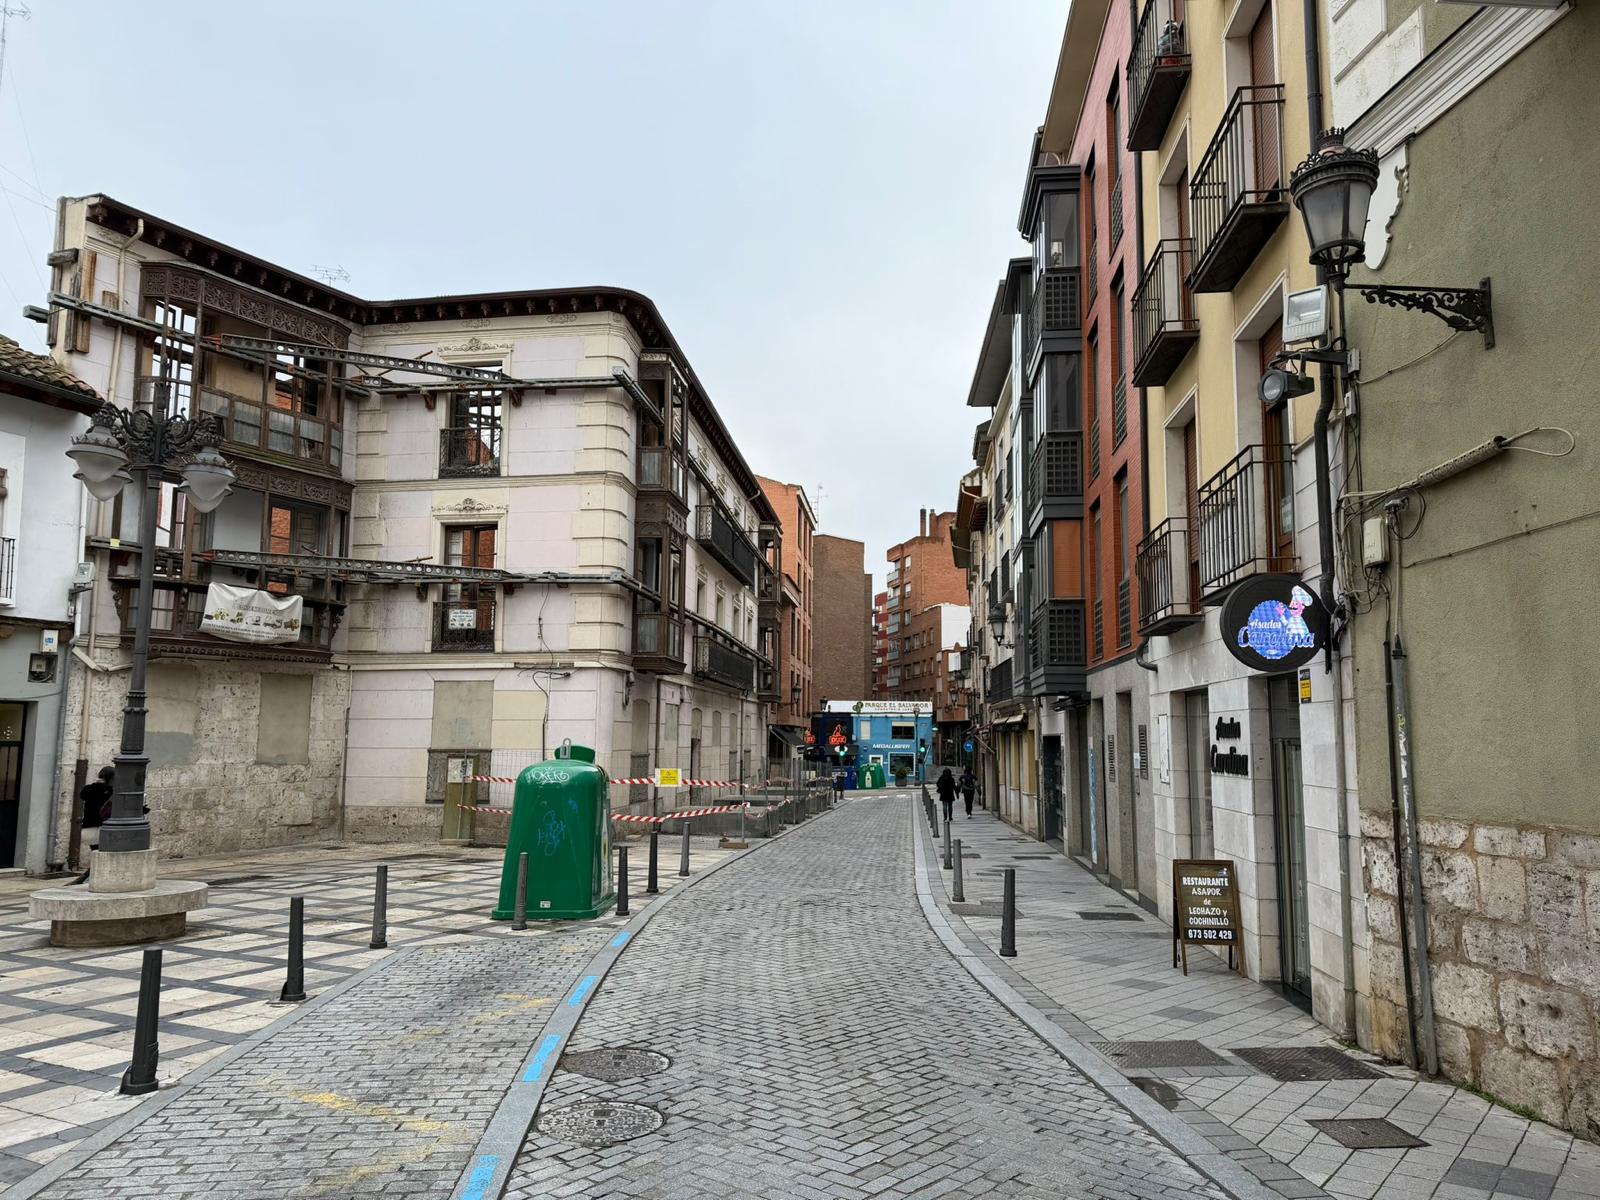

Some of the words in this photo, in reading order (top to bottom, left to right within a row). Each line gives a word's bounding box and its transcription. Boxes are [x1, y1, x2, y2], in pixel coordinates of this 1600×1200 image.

[1250, 618, 1282, 629] Asados
[1237, 626, 1315, 648] Carolina
[1182, 877, 1229, 886] RESTAURANTE
[1191, 887, 1222, 896] ASADOR
[1203, 898, 1212, 906] de
[1188, 907, 1221, 916] LECHAZO
[1188, 917, 1229, 926] COCHINILLO
[1203, 930, 1217, 940] 502
